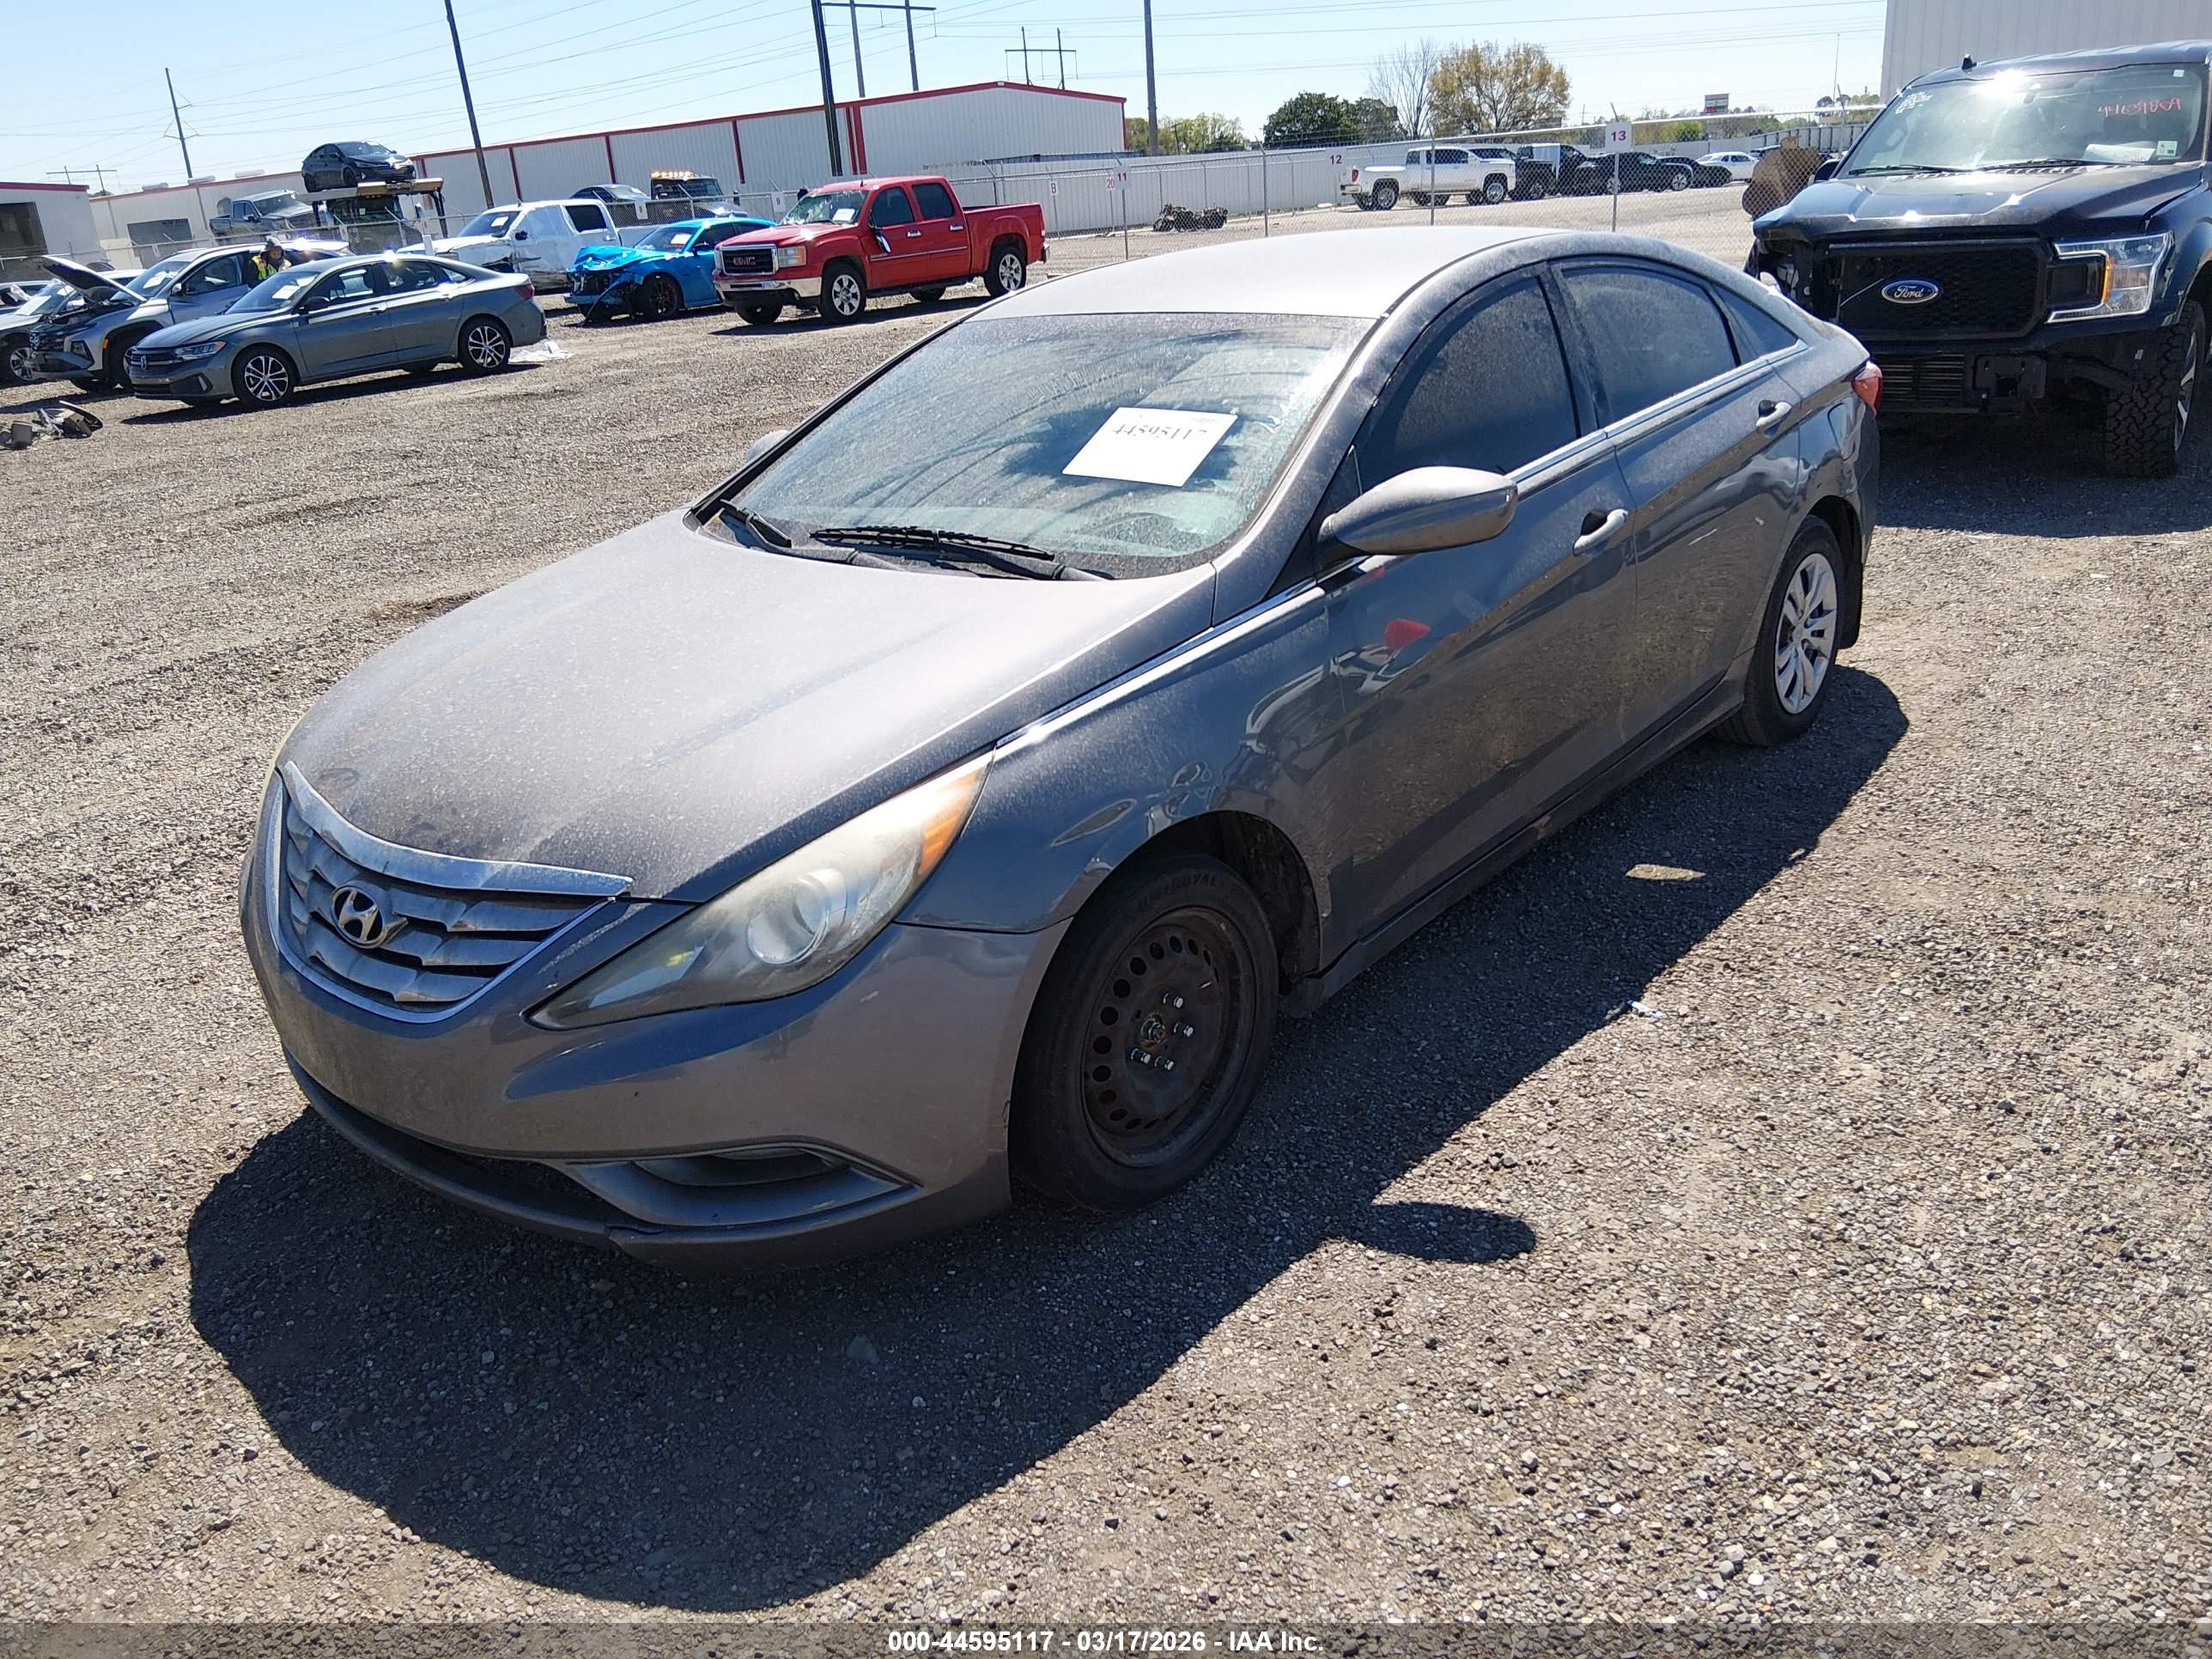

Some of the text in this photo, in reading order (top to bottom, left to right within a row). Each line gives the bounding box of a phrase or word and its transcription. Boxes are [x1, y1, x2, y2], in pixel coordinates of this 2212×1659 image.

[1611, 130, 1626, 142] 13
[1330, 155, 1342, 165] 12
[1117, 173, 1127, 182] 11
[1107, 179, 1115, 189] 20
[733, 257, 756, 265] GMC
[1893, 285, 1924, 298] Ford
